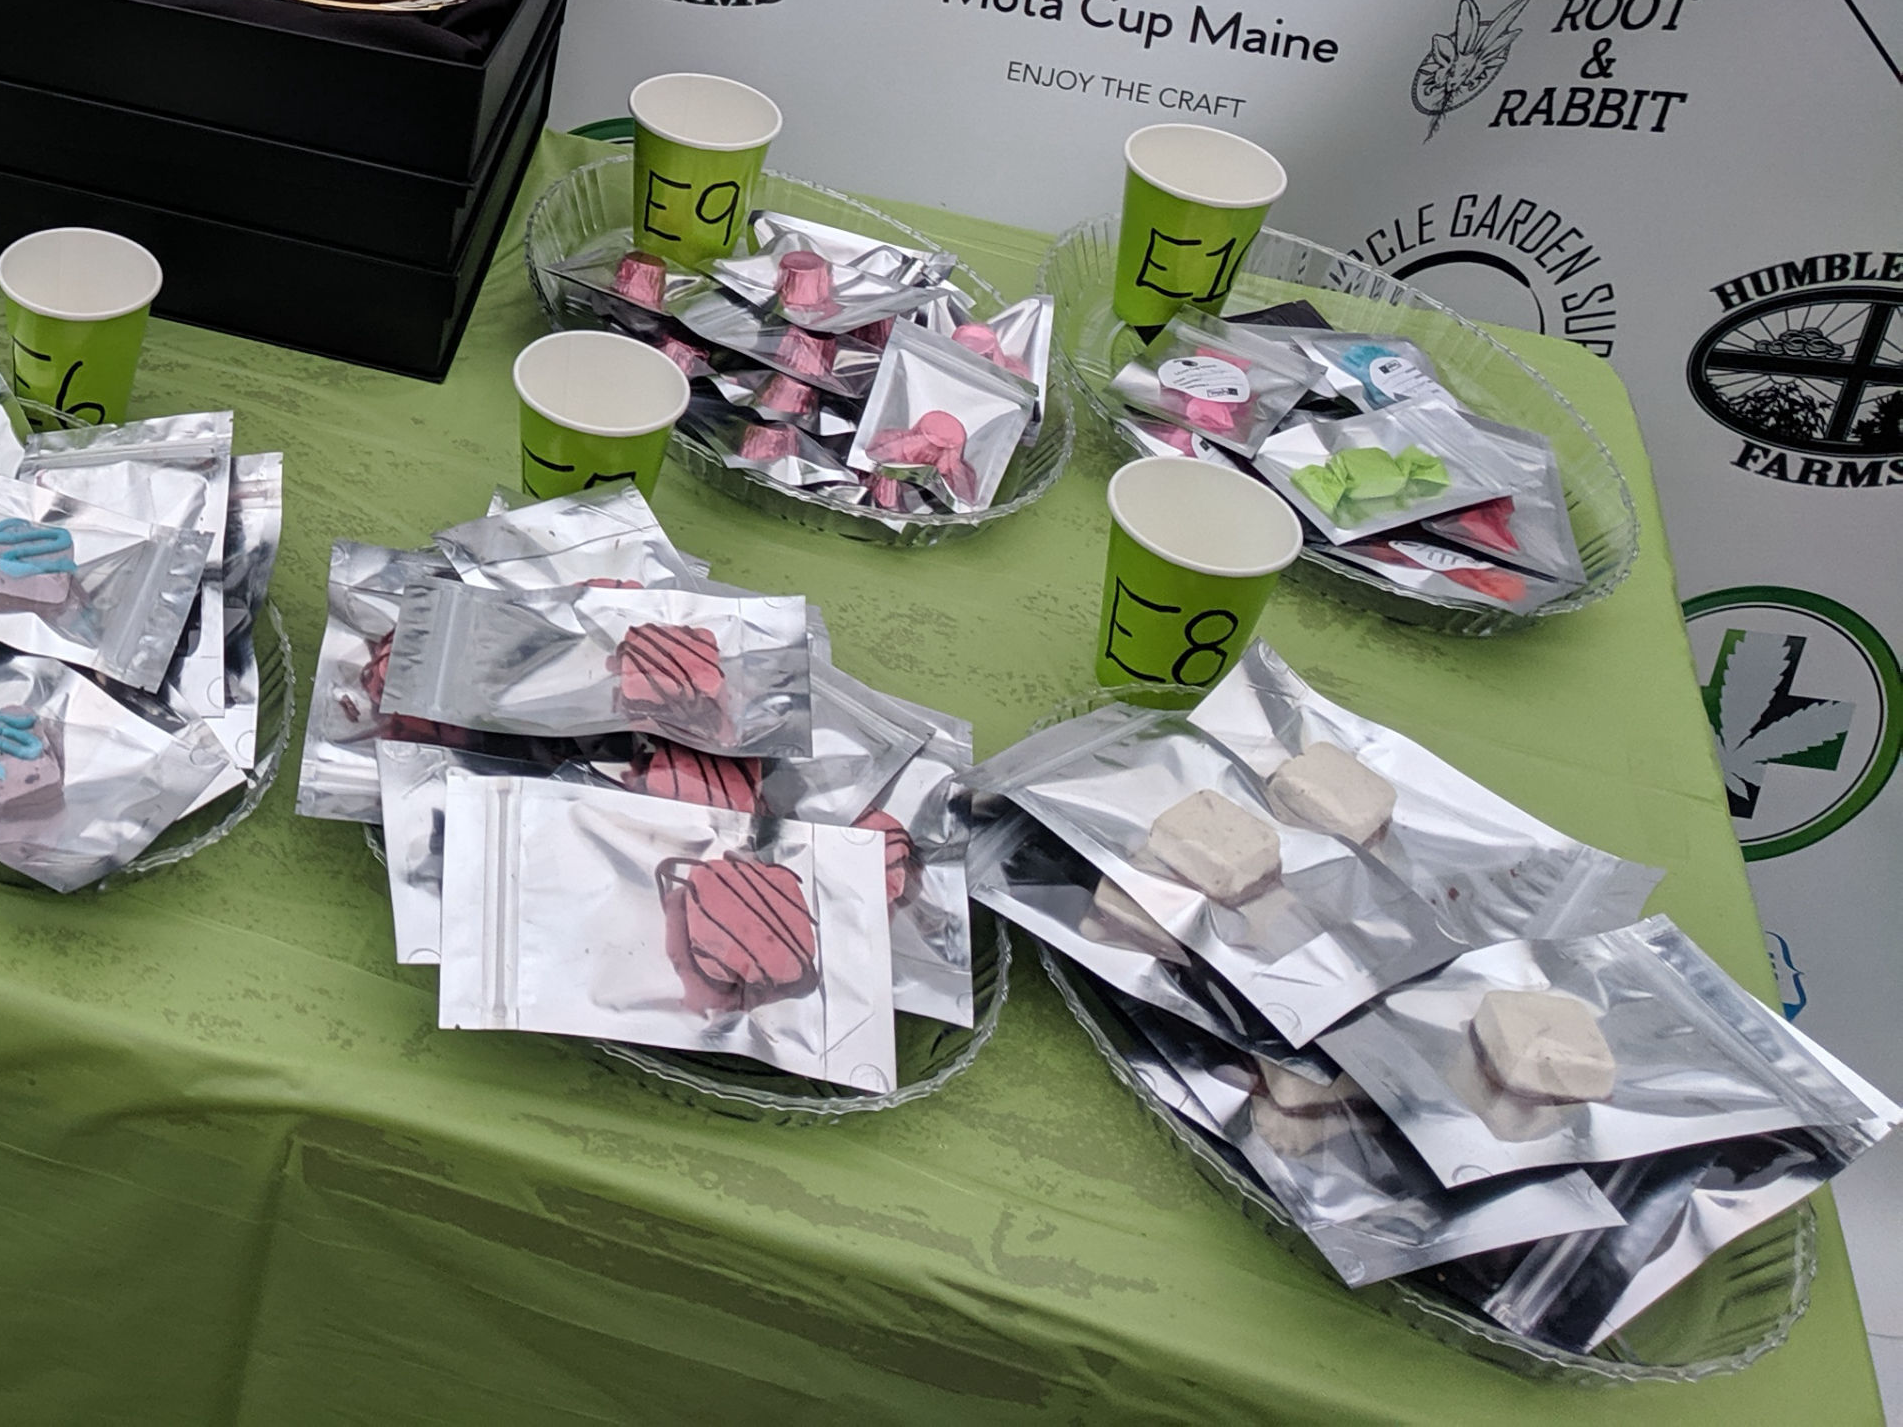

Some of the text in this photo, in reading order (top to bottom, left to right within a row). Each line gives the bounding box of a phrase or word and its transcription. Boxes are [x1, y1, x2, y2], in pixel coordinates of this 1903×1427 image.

[1189, 4, 1340, 64] Maine
[1580, 37, 1616, 79] &
[1007, 61, 1246, 119] ENJOY THE CRAFT
[1489, 87, 1687, 132] RABBIT
[643, 170, 740, 246] E9
[1450, 194, 1601, 285] GARDEN
[1106, 577, 1239, 686] E8
